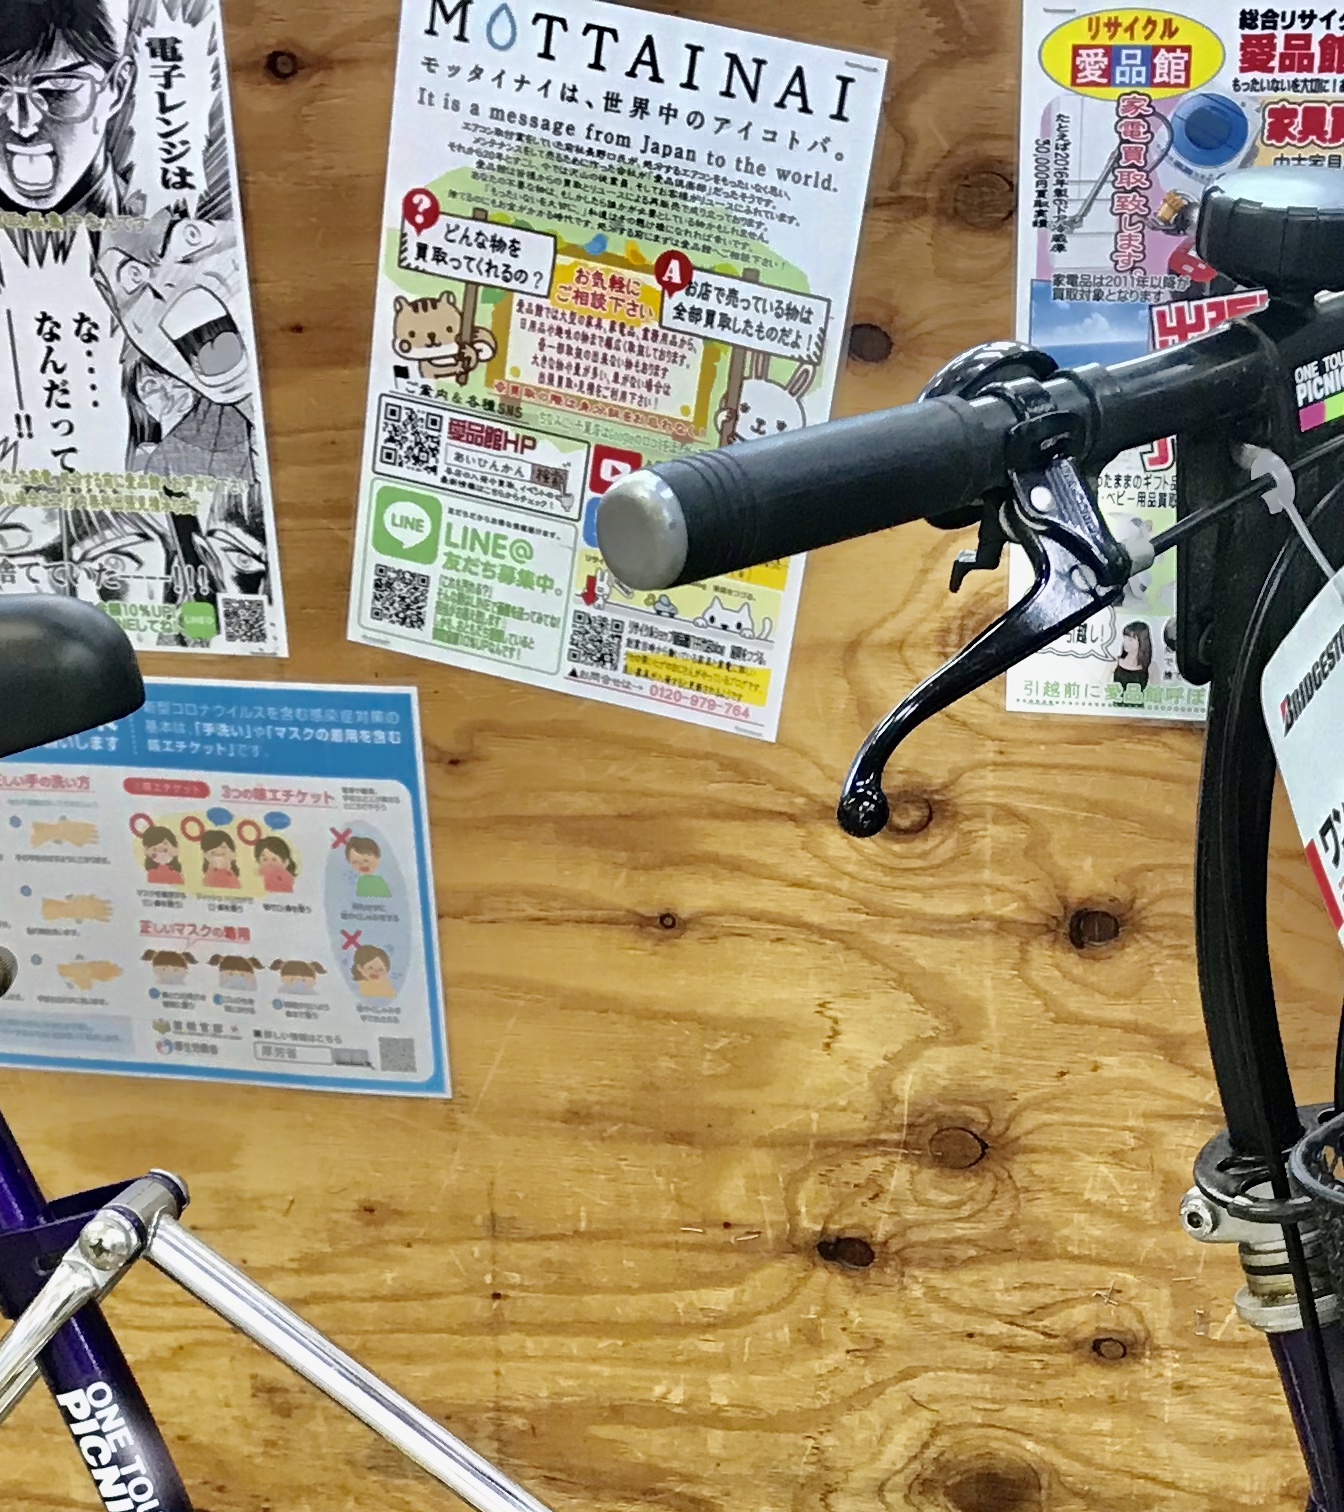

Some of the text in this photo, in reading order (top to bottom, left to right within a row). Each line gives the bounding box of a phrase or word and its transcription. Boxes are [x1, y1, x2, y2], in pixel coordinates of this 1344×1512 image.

[1087, 16, 1178, 41] リサイクル
[1074, 46, 1191, 86] 愛品館
[144, 35, 197, 192] 電子レンジは
[417, 87, 839, 194] It is a message from Japan to the world.
[1113, 92, 1154, 277] 家電買取致します。
[443, 220, 522, 260] どんな物を
[555, 281, 654, 320] ご相談下さい
[574, 266, 642, 298] お気軽に
[684, 276, 813, 327] お店で売っている物は
[672, 302, 815, 353] 全部買取したものだよ！
[1294, 360, 1320, 383] ONE
[33, 310, 80, 475] なんだって
[448, 417, 537, 454] 愛品館HP
[453, 451, 525, 478] あいひんかん
[391, 512, 425, 533] LINE
[444, 521, 534, 564] LINE@
[649, 684, 750, 719] 0120-979-764
[140, 919, 252, 941] 正しいマスクの着用
[84, 1380, 135, 1451] ONE
